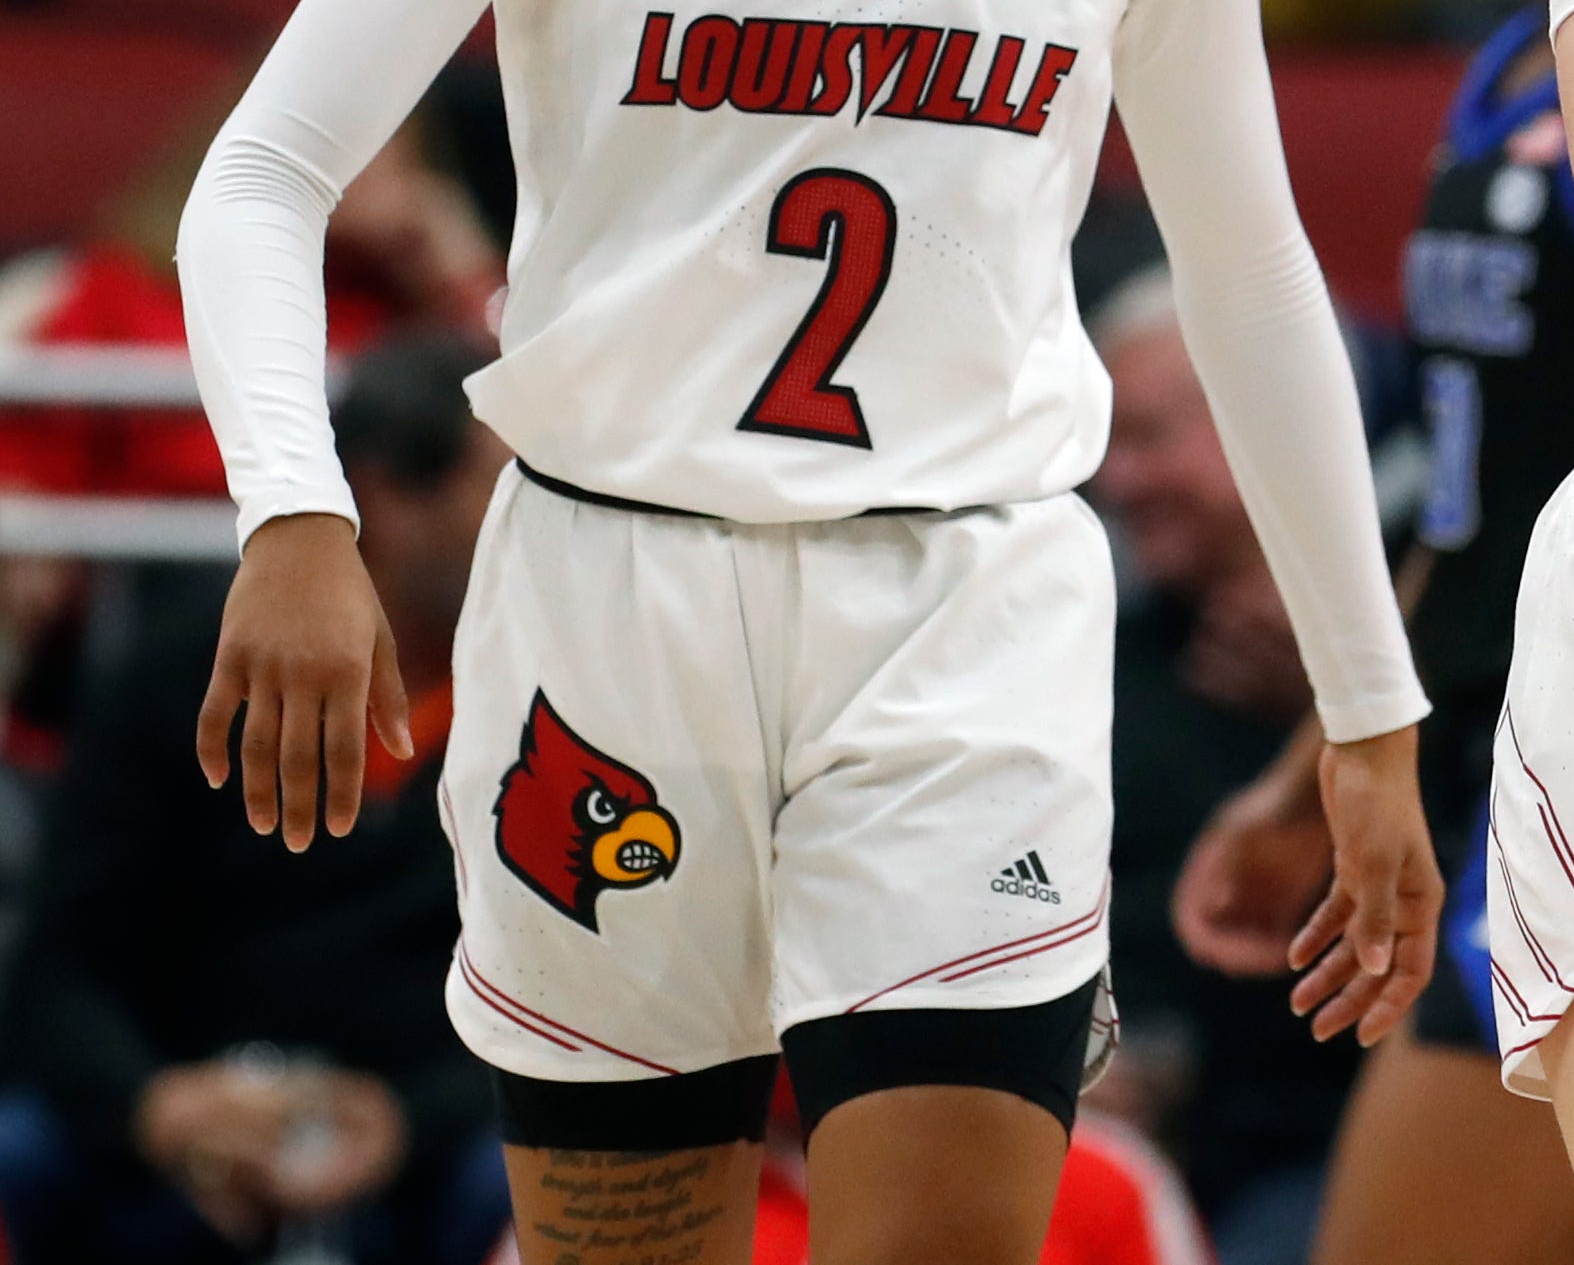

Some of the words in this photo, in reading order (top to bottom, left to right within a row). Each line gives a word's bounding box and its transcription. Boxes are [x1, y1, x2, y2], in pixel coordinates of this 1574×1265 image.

[619, 11, 1079, 137] LOUISVILLE
[734, 167, 898, 451] 2
[990, 878, 1063, 906] adidas
